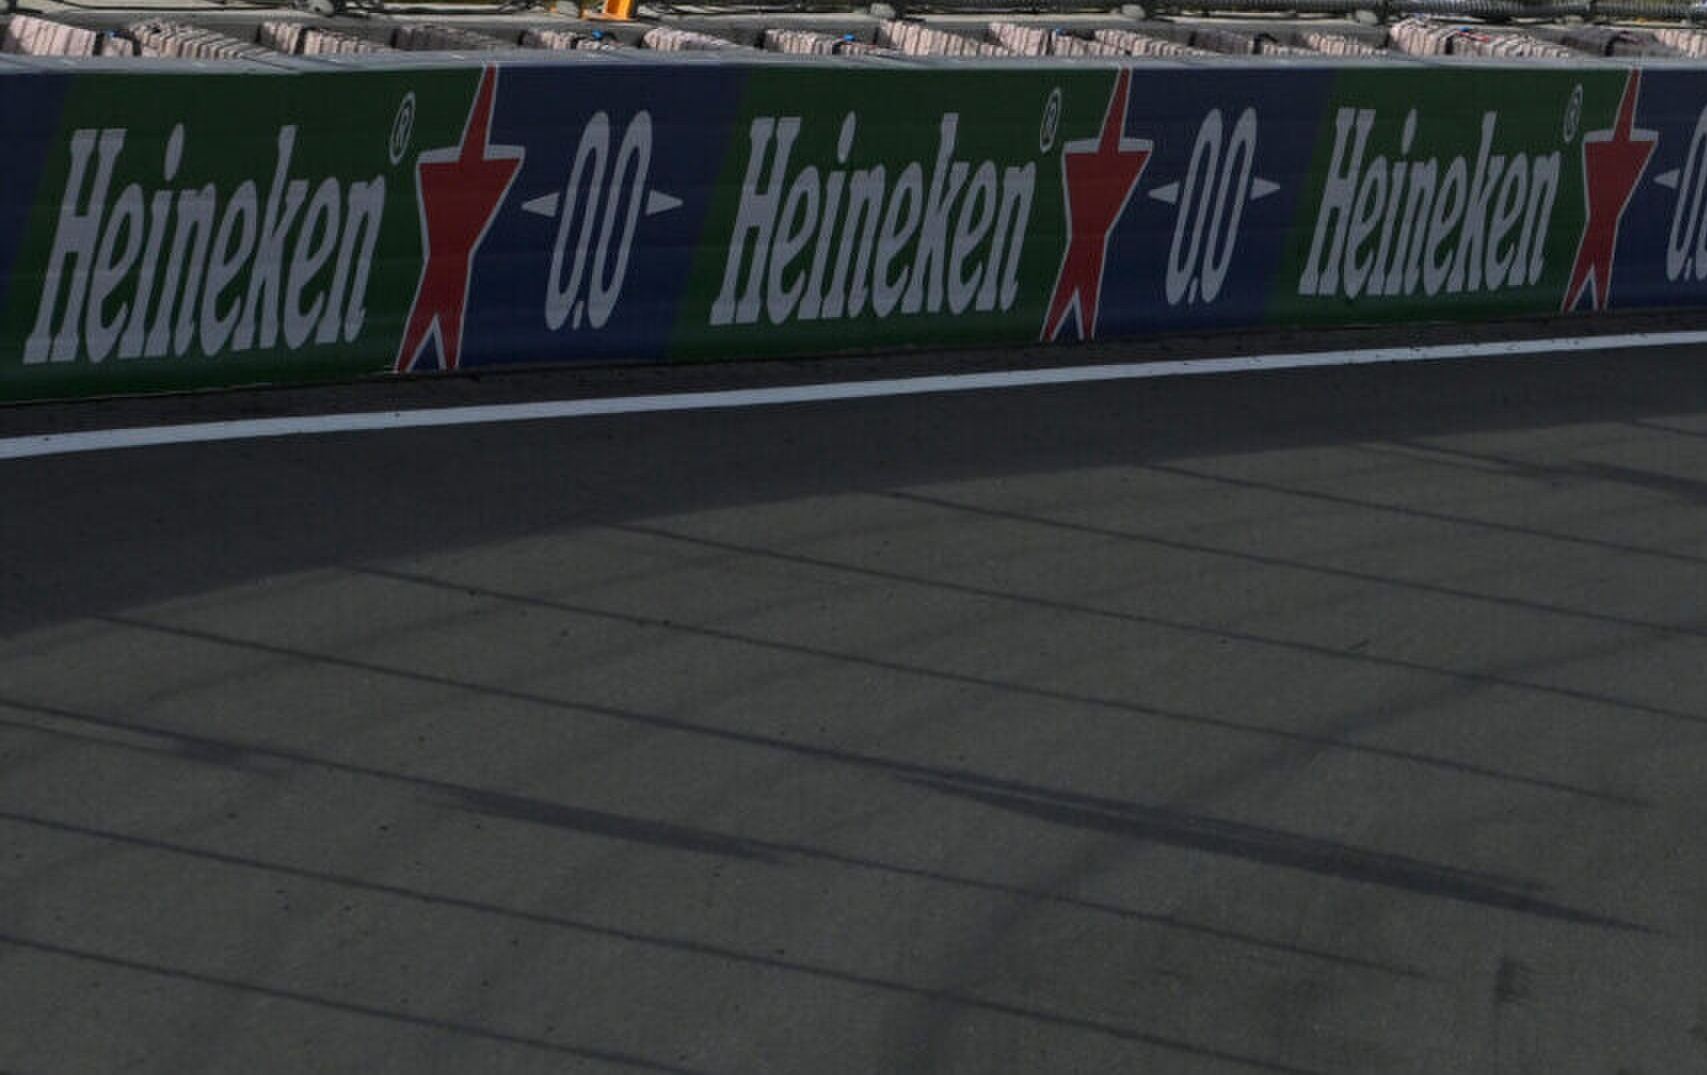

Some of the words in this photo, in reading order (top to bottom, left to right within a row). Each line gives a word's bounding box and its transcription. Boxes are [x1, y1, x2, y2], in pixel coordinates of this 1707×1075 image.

[23, 124, 386, 365] Heineken
[545, 110, 653, 330] 0.0
[709, 111, 1036, 325] Heineken
[1166, 107, 1258, 306] 0.0
[1298, 107, 1562, 299] Heineken
